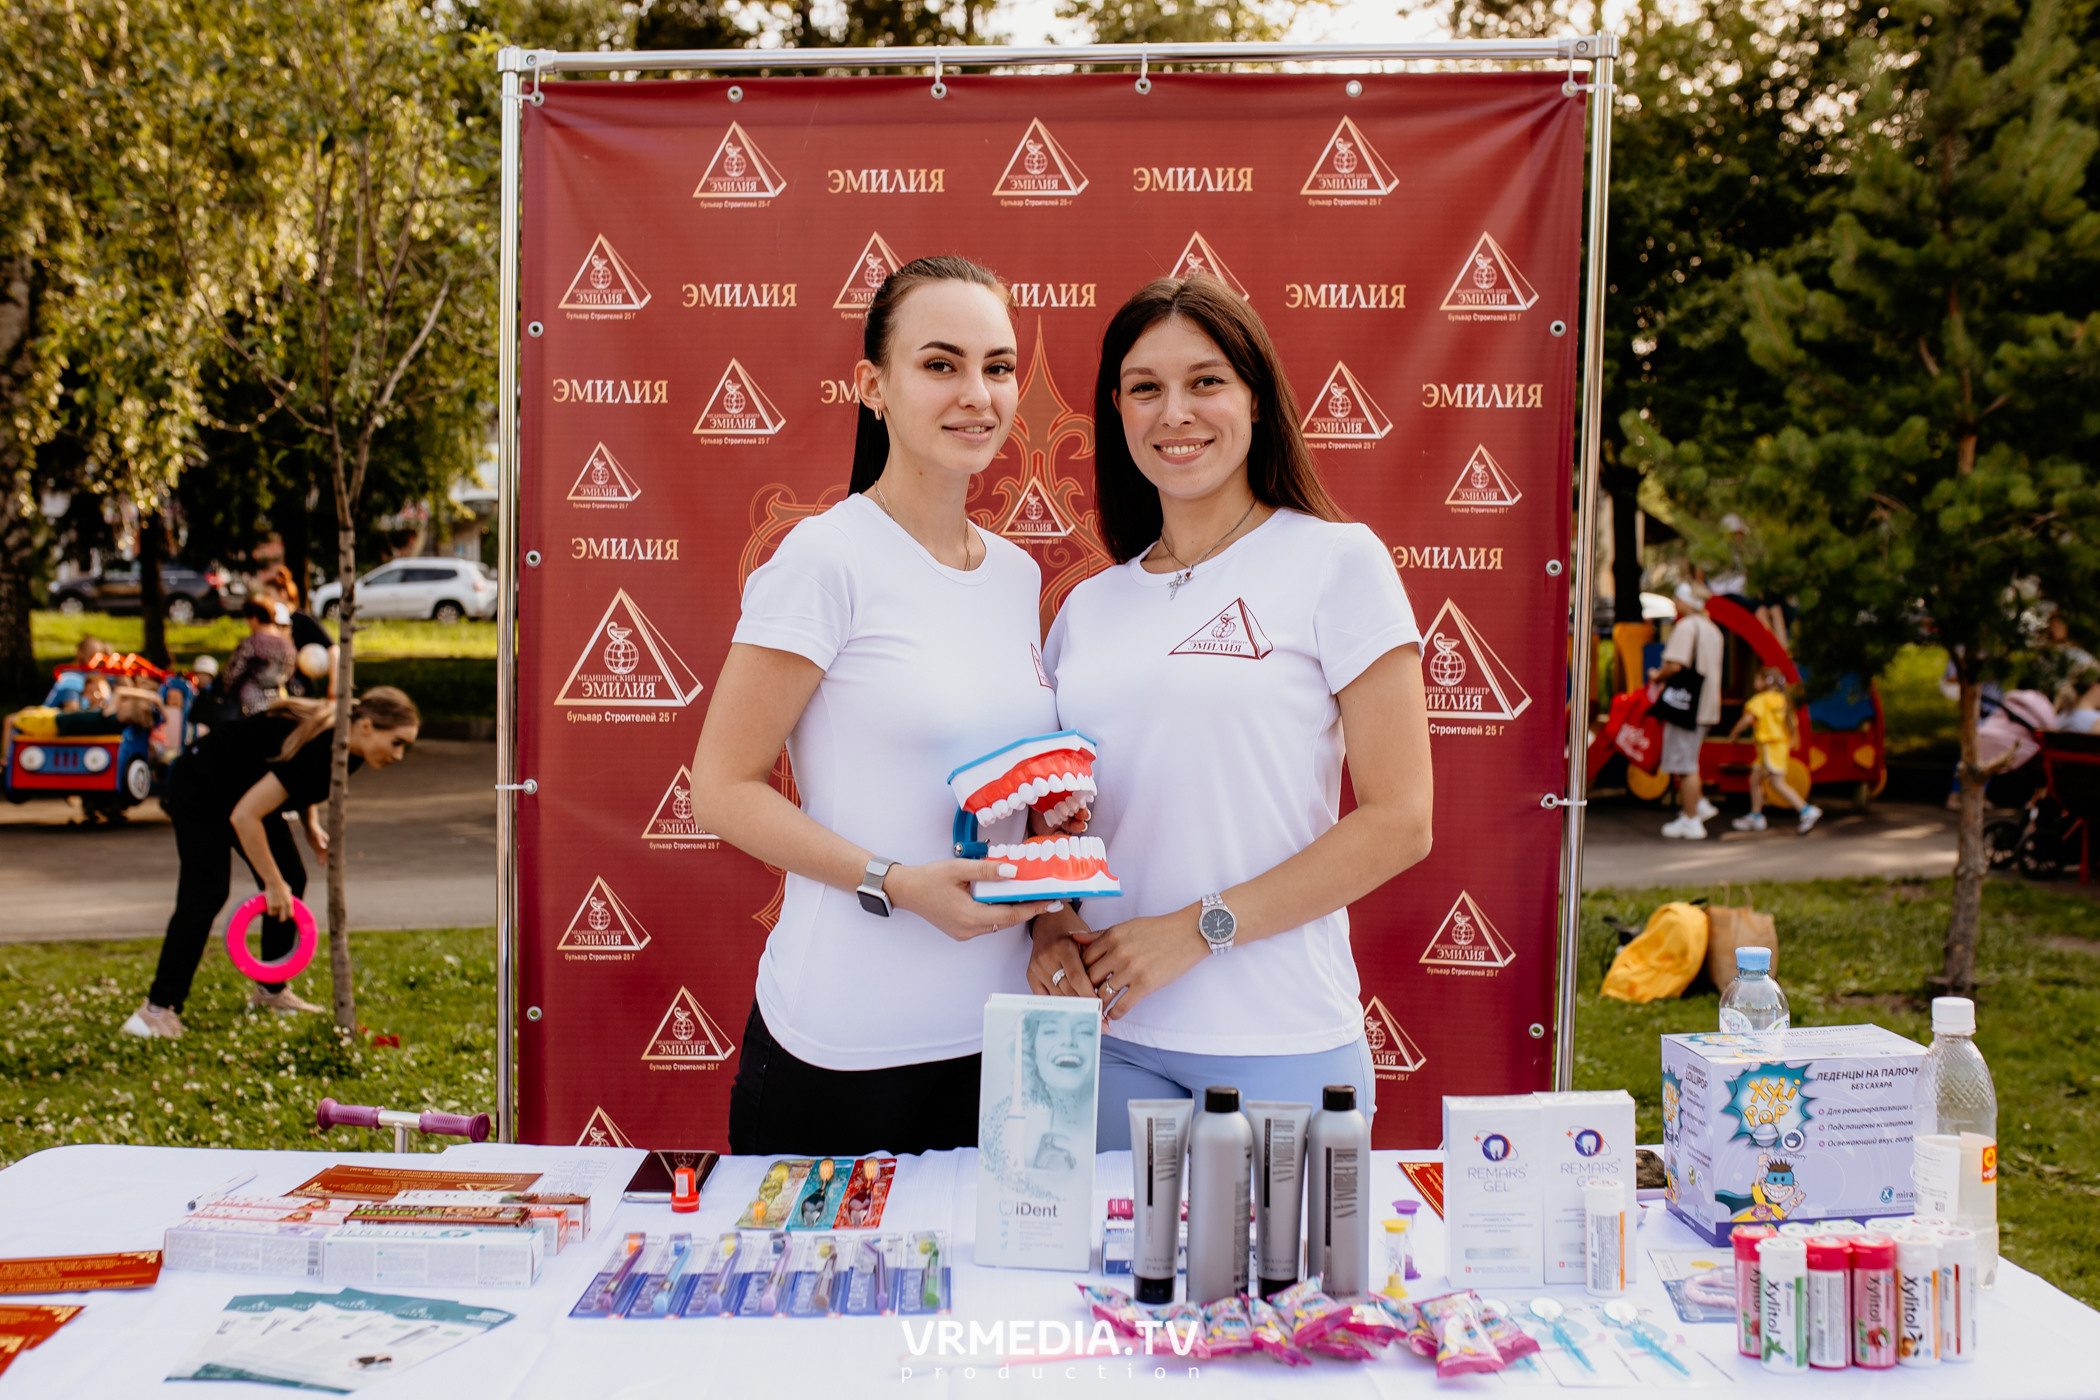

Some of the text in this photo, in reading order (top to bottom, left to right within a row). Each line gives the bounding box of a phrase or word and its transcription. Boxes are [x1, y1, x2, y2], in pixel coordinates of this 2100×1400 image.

[828, 169, 944, 193] ЭМИЛИЯ
[1134, 168, 1252, 191] ЭМИЛИЯ
[1318, 178, 1368, 189] ЭМИЛИЯ
[576, 293, 622, 304] ЭМИЛИЯ
[683, 284, 796, 307] ЭМИЛИЯ
[1286, 284, 1405, 308] ЭМИЛИЯ
[1458, 293, 1507, 304] ЭМИЛИЯ
[553, 379, 667, 403] ЭМИЛИЯ
[1423, 384, 1542, 408] ЭМИЛИЯ
[710, 418, 756, 429] ЭМИЛИЯ
[1313, 422, 1362, 433] ЭМИЛИЯ
[572, 538, 678, 560] ЭМИЛИЯ
[1393, 545, 1503, 570] ЭМИЛИЯ
[582, 682, 656, 698] ЭМИЛИЯ
[567, 711, 678, 724] бульвар Строителей 25 Г
[1430, 723, 1505, 736] Строителей 25 Г
[574, 934, 621, 945] ЭМИЛИЯ
[1437, 949, 1485, 960] ЭМИЛИЯ
[659, 1044, 705, 1055] ЭМИЛИЯ
[1816, 1069, 1864, 1082] ЛЕДЕНЦЫ
[1866, 1069, 1879, 1078] НА
[1865, 1081, 1893, 1090] САХАРА
[1468, 1166, 1526, 1179] REMARS
[1561, 1161, 1619, 1176] REMARS
[1483, 1181, 1511, 1193] GEL
[1015, 1201, 1058, 1218] iDent
[1866, 1276, 1882, 1323] Xylitol
[1900, 1274, 1920, 1329] Xylitol
[1764, 1279, 1782, 1335] Xylitol
